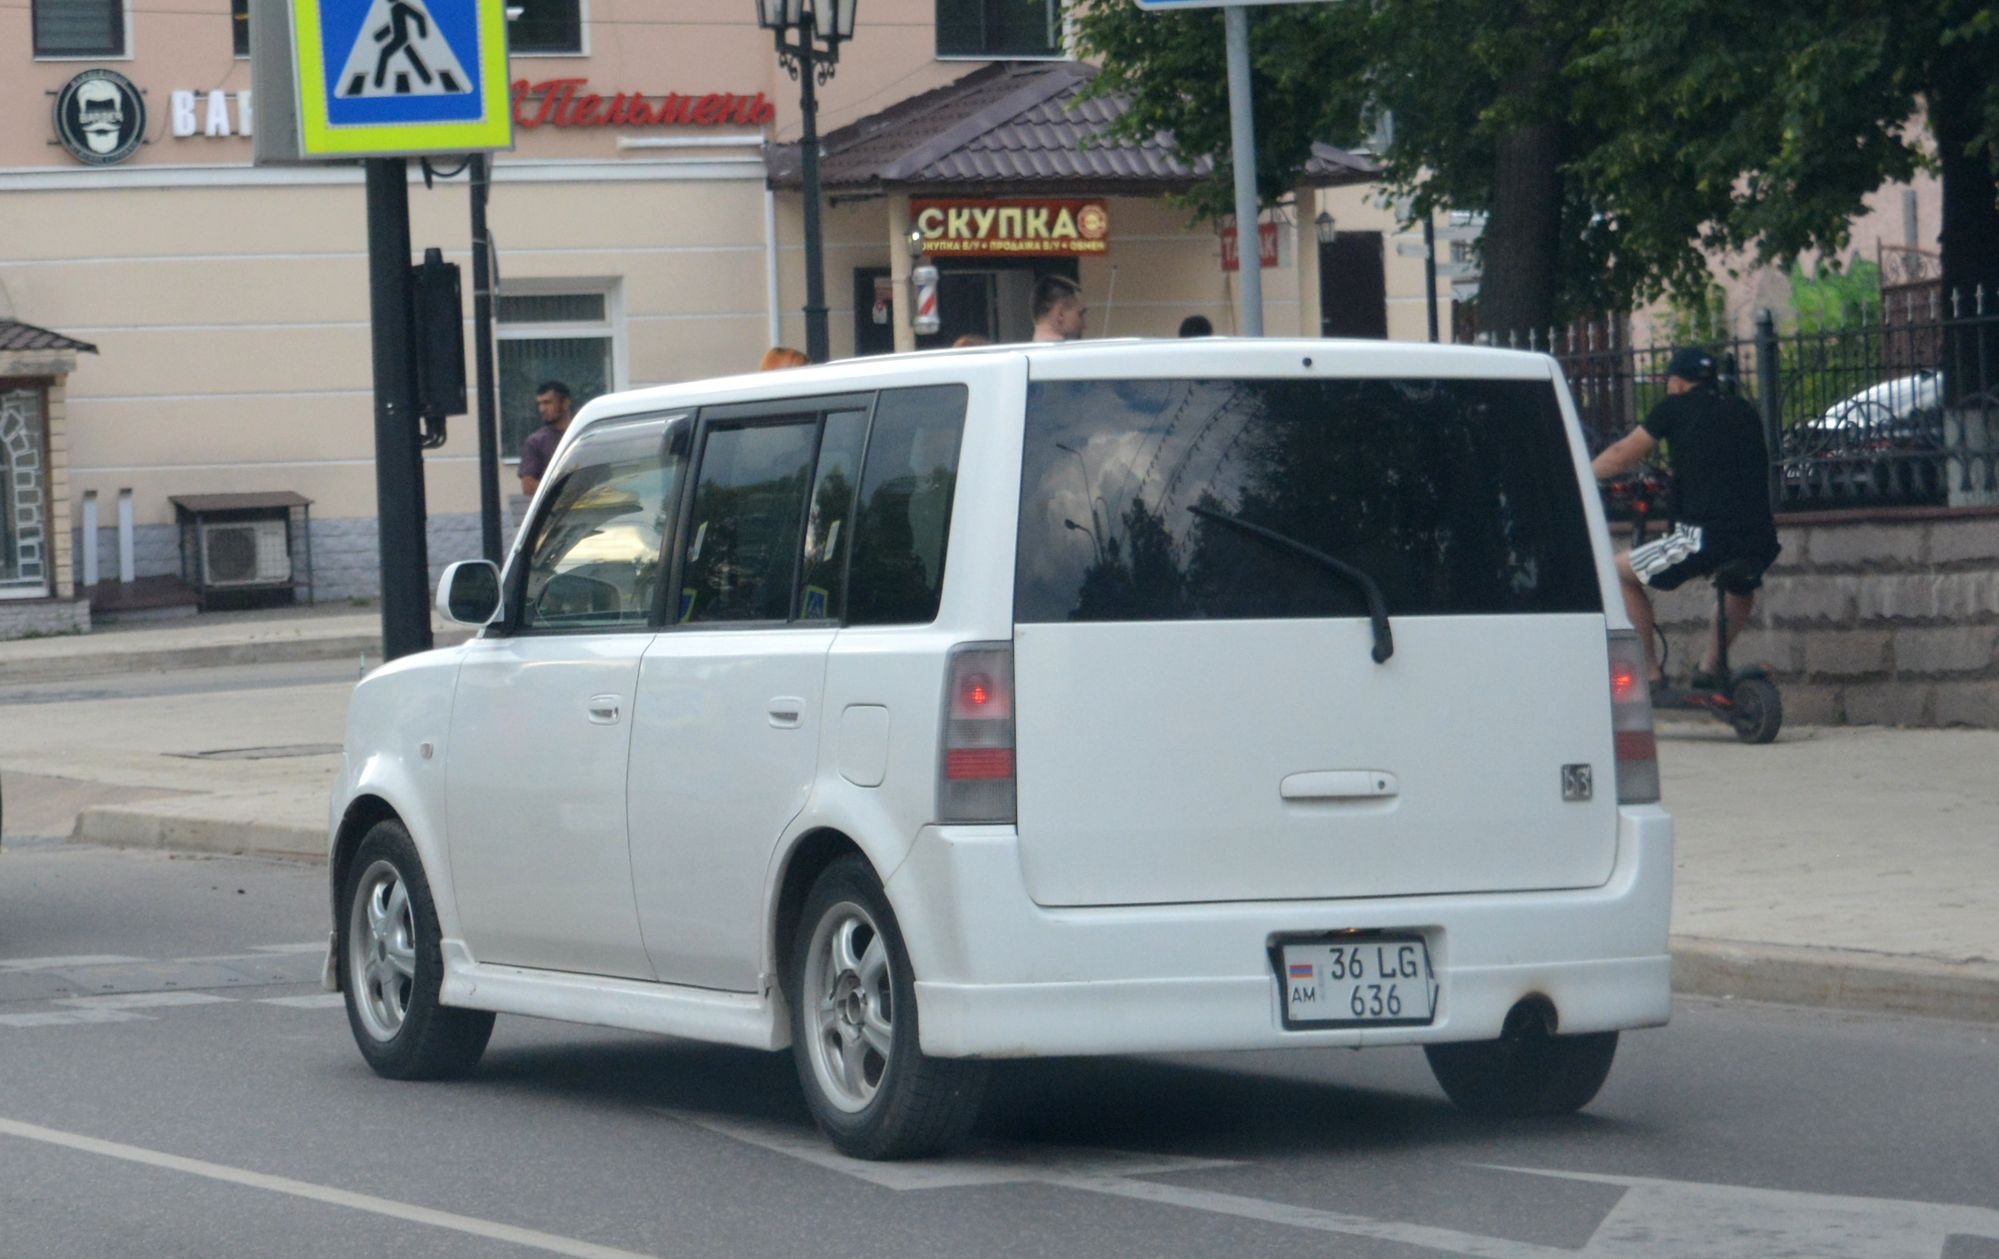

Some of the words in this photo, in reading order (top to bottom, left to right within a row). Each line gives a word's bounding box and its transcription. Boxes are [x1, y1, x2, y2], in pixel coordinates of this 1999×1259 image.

[918, 206, 1078, 240] СКУПКА
[989, 240, 1041, 251] ПРОДАЖА
[1069, 240, 1105, 251] ОБМЕН
[1329, 947, 1364, 980] 36
[1377, 946, 1418, 979] LG
[1291, 986, 1316, 1004] AM
[1350, 984, 1402, 1016] 636
